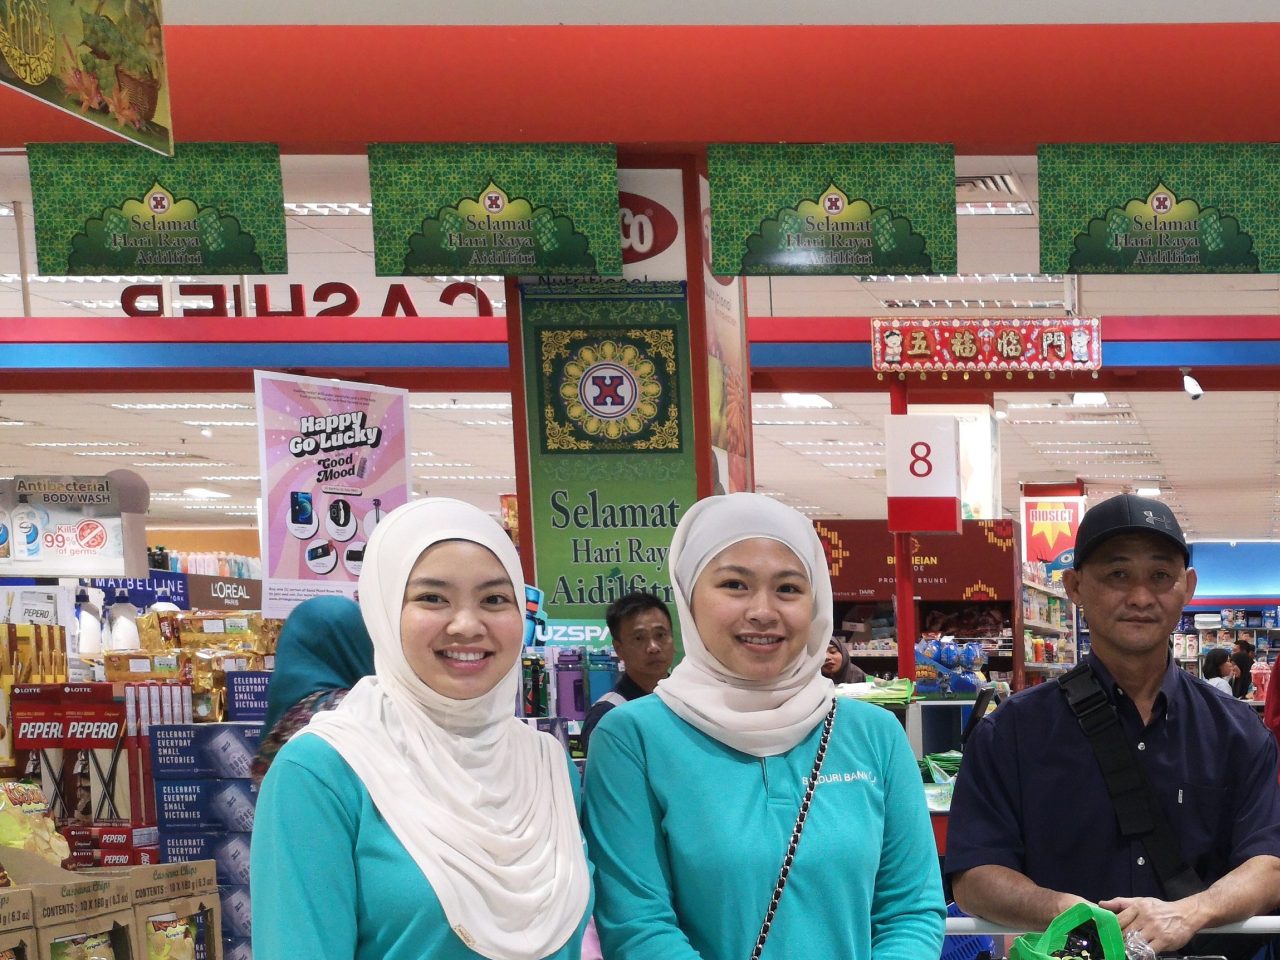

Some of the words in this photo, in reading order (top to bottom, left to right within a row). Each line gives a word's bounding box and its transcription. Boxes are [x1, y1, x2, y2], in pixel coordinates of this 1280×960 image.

[131, 215, 200, 231] Selamat
[466, 215, 533, 231] Selamat
[804, 214, 873, 231] Selamat
[1132, 214, 1200, 231] Selamat
[112, 233, 151, 248] Hari
[158, 233, 200, 250] Raya
[448, 233, 487, 248] Hari
[492, 233, 534, 250] Raya
[786, 233, 826, 248] Hari
[831, 233, 873, 250] Raya
[1113, 233, 1153, 248] Hari
[1158, 233, 1200, 250] Raya
[136, 249, 202, 264] Aidilfitri
[470, 250, 536, 265] Aidilfitri
[808, 249, 873, 265] Aidilfitri
[1134, 248, 1200, 264] Aidilfitri
[301, 411, 366, 434] Happy
[289, 436, 318, 456] Go
[318, 425, 382, 451] Lucky
[317, 453, 353, 471] Good
[909, 441, 934, 478] 8
[316, 465, 356, 483] Mood
[17, 480, 110, 493] Antibacterial
[43, 494, 77, 503] BODY
[78, 494, 111, 503] WASH
[550, 489, 681, 529] Selamat
[1030, 509, 1073, 522] RIDSECT
[57, 525, 77, 534] Kills
[44, 533, 77, 549] 99%
[70, 548, 97, 557] germs
[571, 538, 622, 564] Hari
[627, 538, 671, 571] Ray
[95, 577, 185, 593] MAYBELLINE
[550, 574, 674, 605] Aidilfitr
[23, 608, 50, 619] PEPERO
[233, 677, 269, 685] CELEBRATE
[234, 685, 266, 693] EVERYDAY
[234, 693, 256, 701] SMALL
[235, 701, 269, 709] VICTORIES
[67, 721, 119, 739] PEPERO
[156, 730, 195, 738] CELEBRATE
[157, 739, 192, 747] EVERYDAY
[158, 747, 180, 756] SMALL
[159, 756, 195, 764] VICTORIES
[162, 786, 201, 794] CELEBRATE
[163, 794, 197, 802] EVERYDAY
[164, 803, 186, 811] SMALL
[165, 811, 201, 819] VICTORIES
[102, 834, 127, 844] PEPERO
[167, 838, 205, 847] CELEBRATE
[168, 847, 201, 855] EVERYDAY
[104, 855, 129, 864] PEPERO
[168, 855, 189, 863] SMALL
